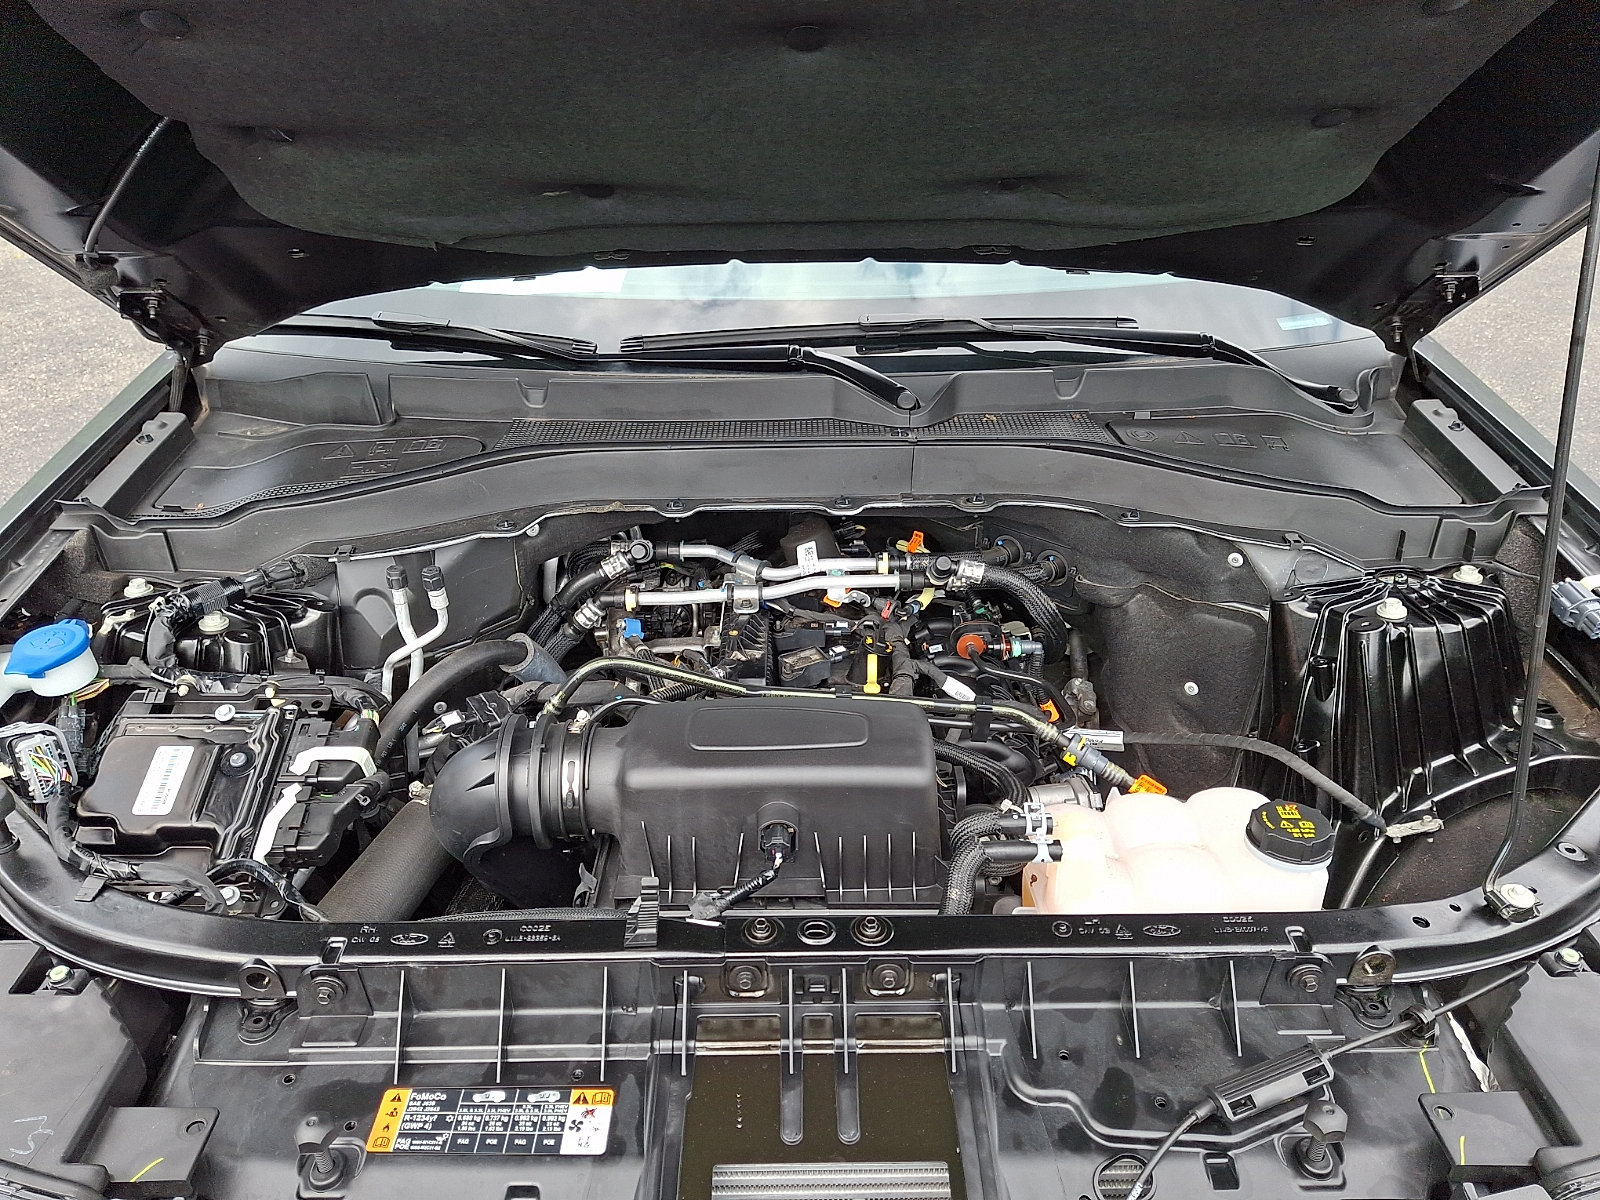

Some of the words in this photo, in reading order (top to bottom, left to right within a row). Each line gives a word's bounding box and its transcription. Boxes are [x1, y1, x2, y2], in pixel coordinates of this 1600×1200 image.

[410, 1092, 447, 1101] FoMoCo
[404, 1114, 438, 1122] R-1234yf
[401, 1122, 423, 1130] (GWP
[424, 1122, 432, 1130] 4)
